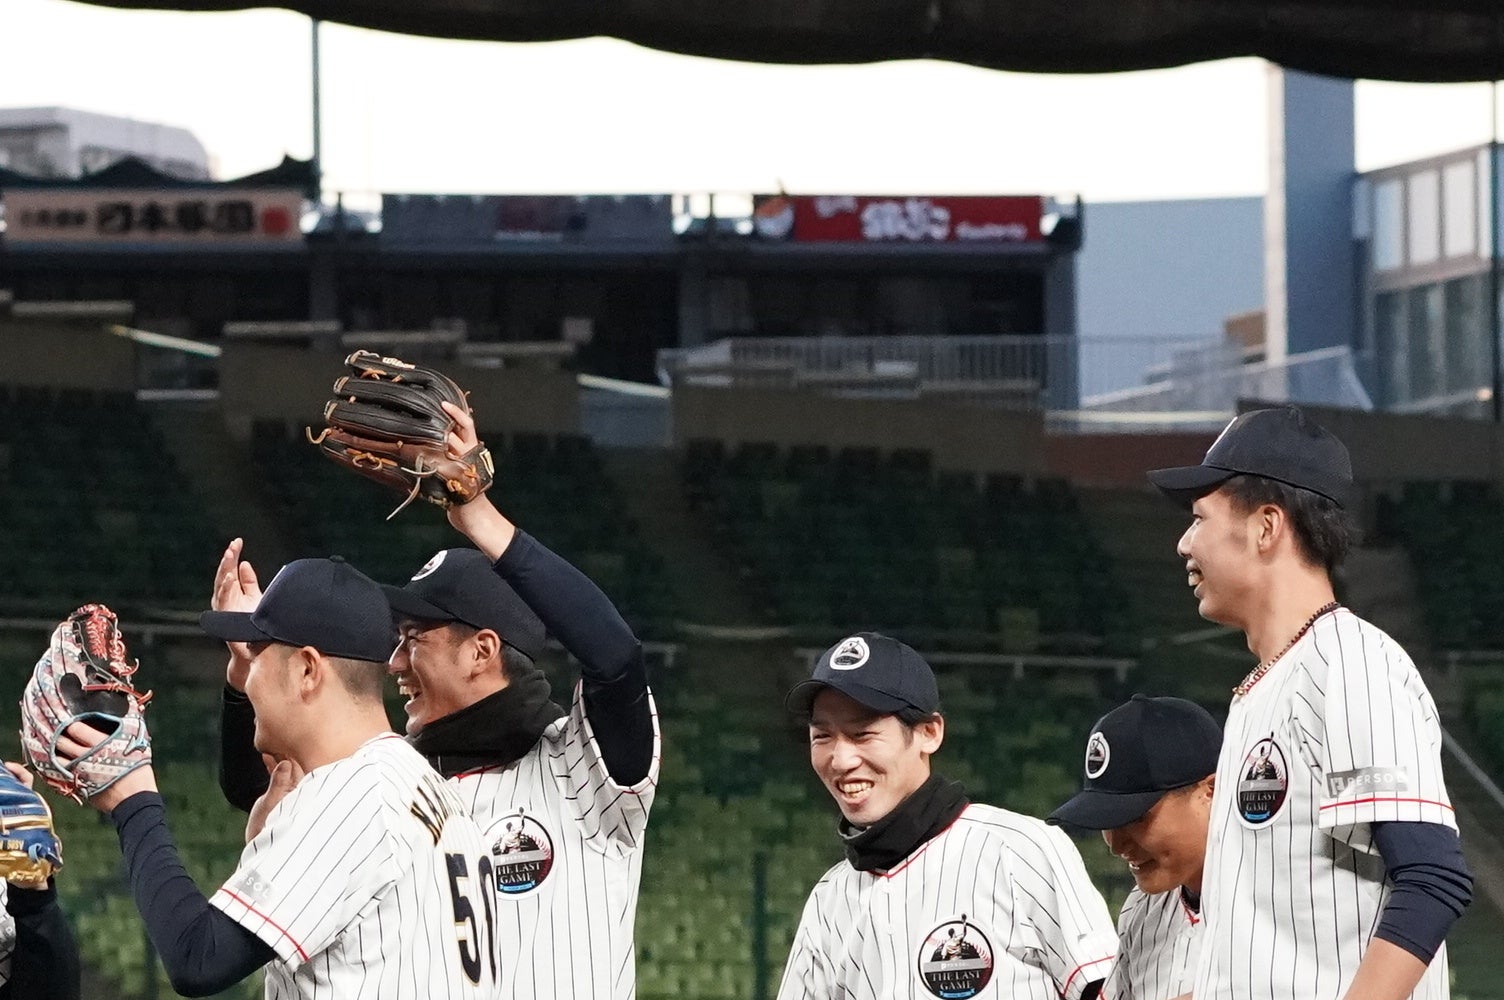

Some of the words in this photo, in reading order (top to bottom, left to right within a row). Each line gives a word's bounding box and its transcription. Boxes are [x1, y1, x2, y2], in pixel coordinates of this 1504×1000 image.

[514, 862, 542, 875] LAST
[499, 872, 533, 885] GAME
[955, 970, 982, 982] LAST
[940, 980, 974, 991] GAME
